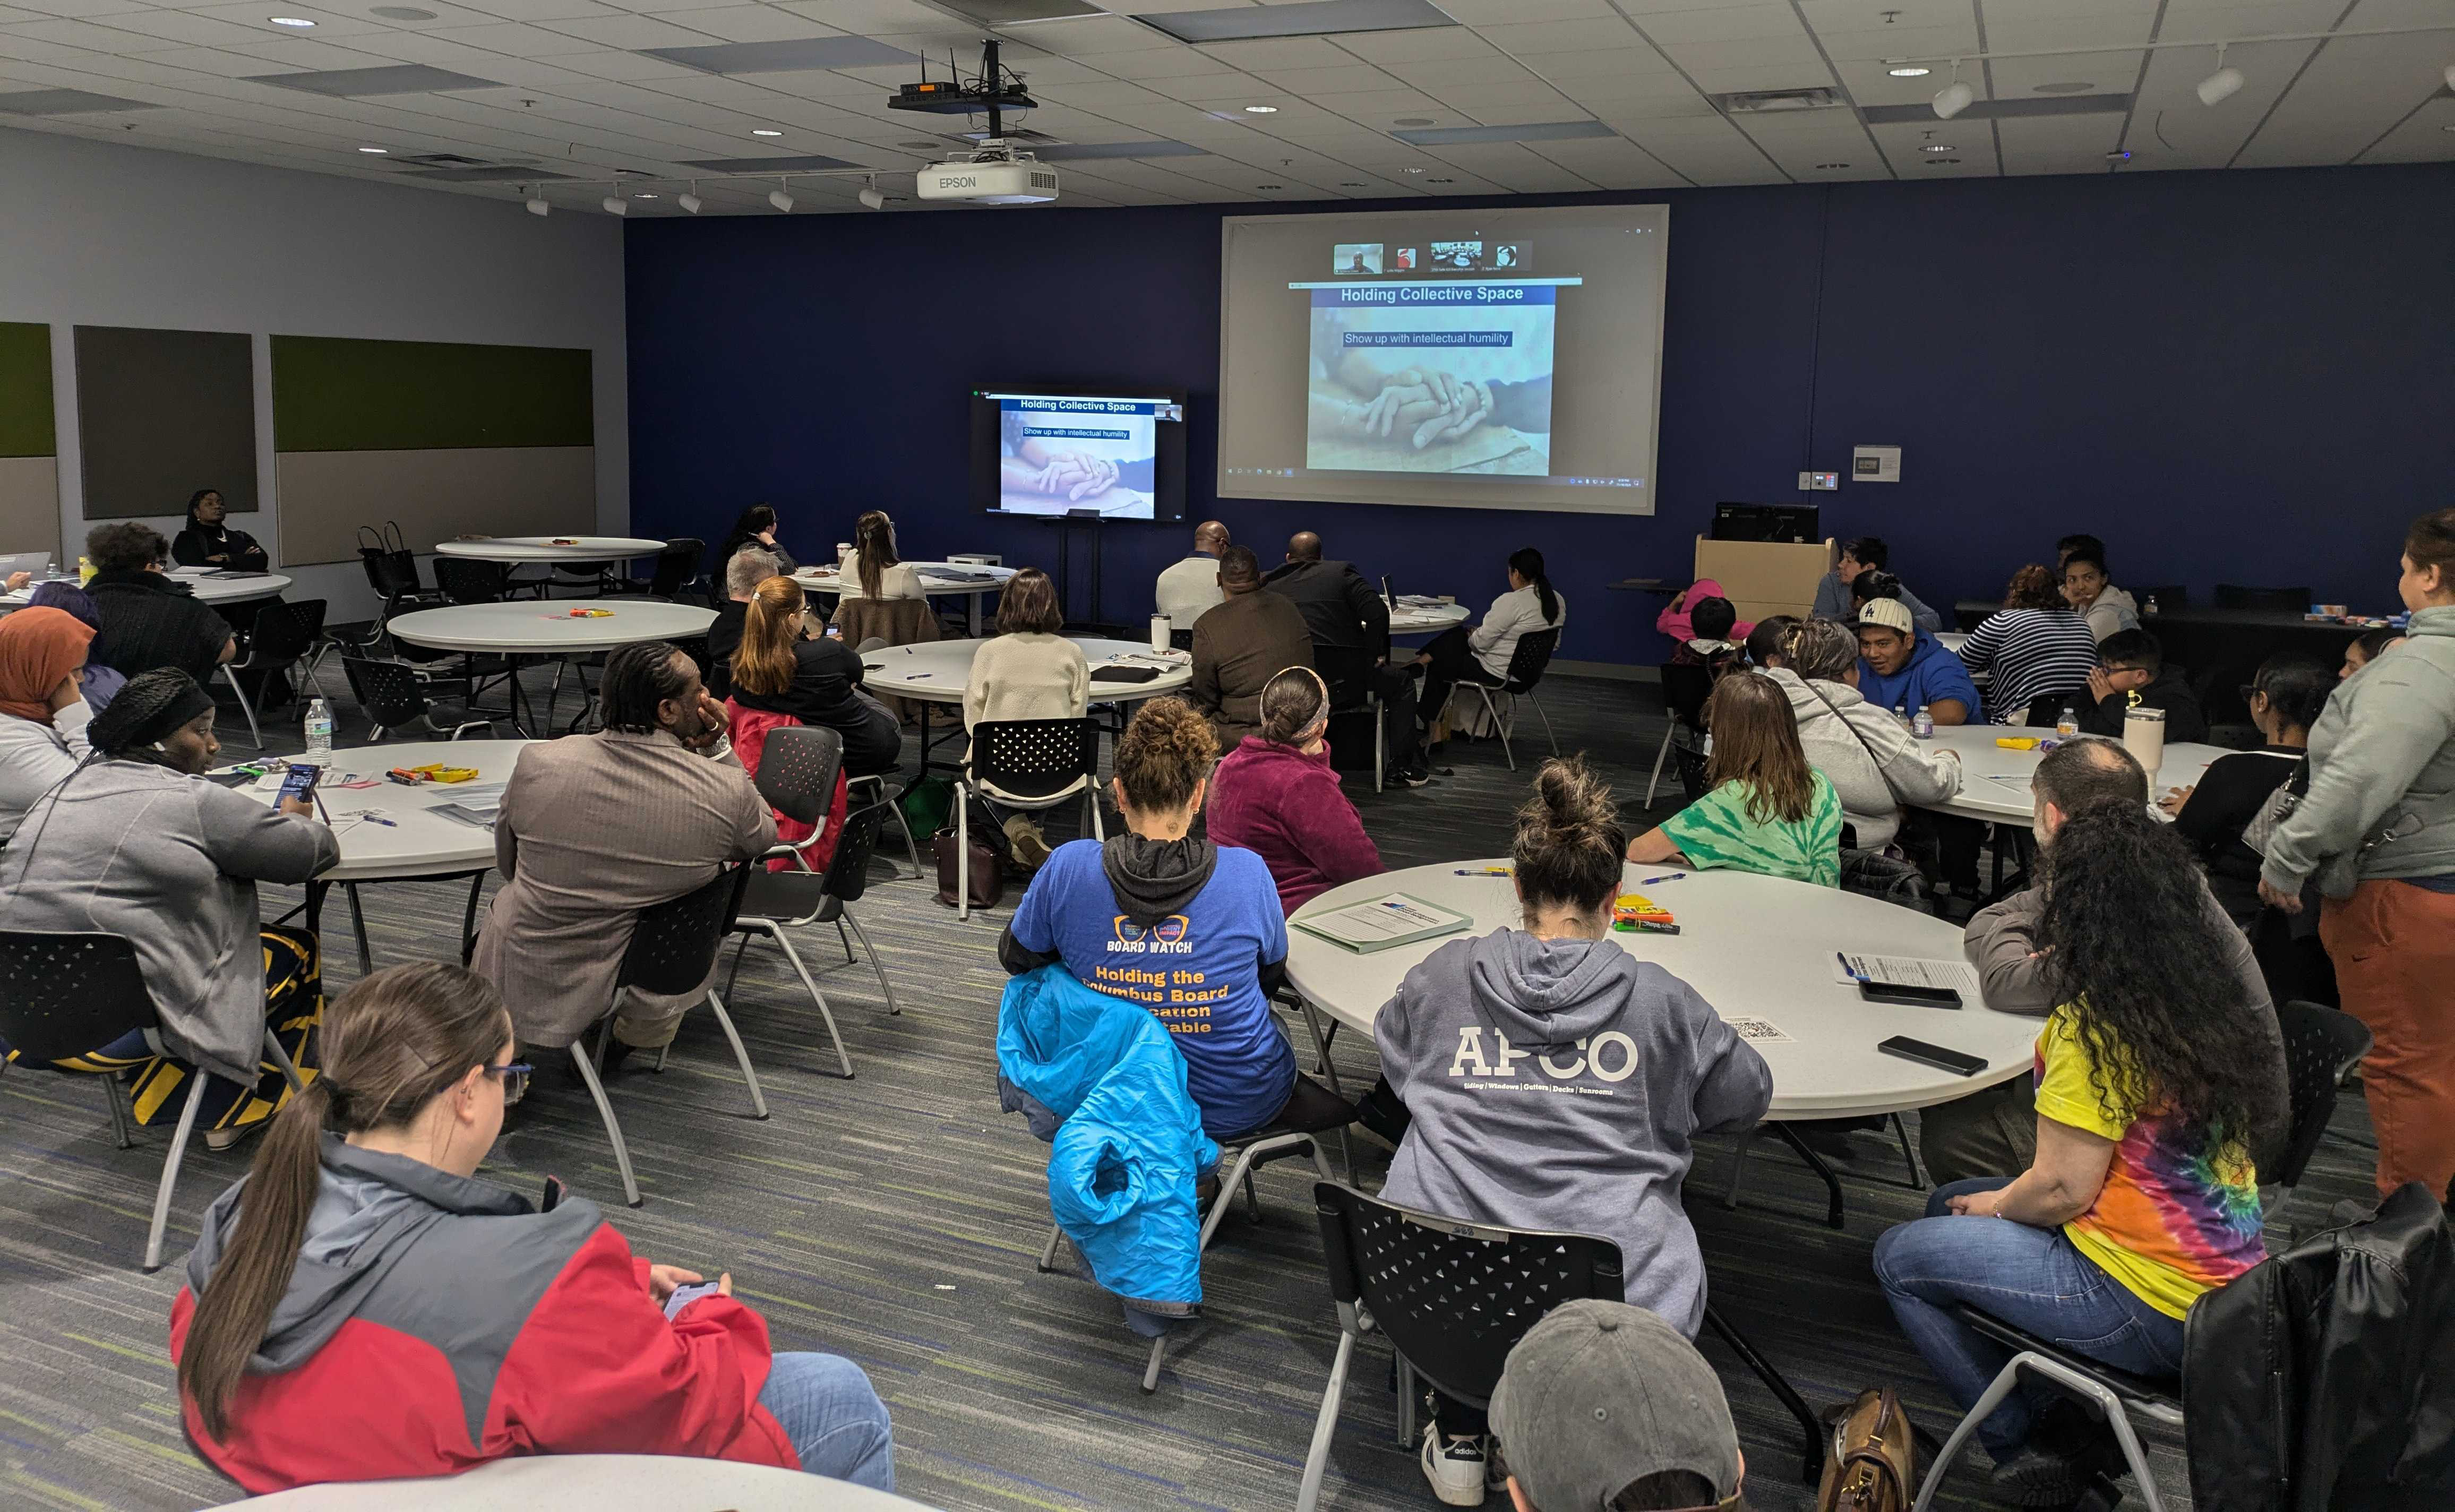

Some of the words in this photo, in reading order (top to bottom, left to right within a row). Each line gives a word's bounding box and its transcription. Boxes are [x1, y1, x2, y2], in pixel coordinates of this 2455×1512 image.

[940, 177, 976, 188] EPSON
[1342, 288, 1396, 304] Holding
[1401, 287, 1473, 301] Collective
[1477, 287, 1524, 303] Space
[1345, 333, 1372, 343] Show
[1375, 336, 1387, 345] up
[1390, 333, 1410, 343] with
[1413, 333, 1466, 343] intellectual
[1469, 333, 1508, 345] humility
[1021, 399, 1057, 410] Holding
[1059, 401, 1105, 410] Collective
[1107, 402, 1136, 412] Space
[1103, 430, 1128, 439] humility
[1107, 941, 1146, 953] BOARD
[1150, 942, 1192, 953] WATCH
[1095, 966, 1166, 987] Holding
[1172, 970, 1205, 984] the
[1171, 985, 1229, 1002] Board
[1147, 1006, 1211, 1017] cation
[1552, 1085, 1574, 1094] Decks
[1579, 1087, 1613, 1096] Sunrooms
